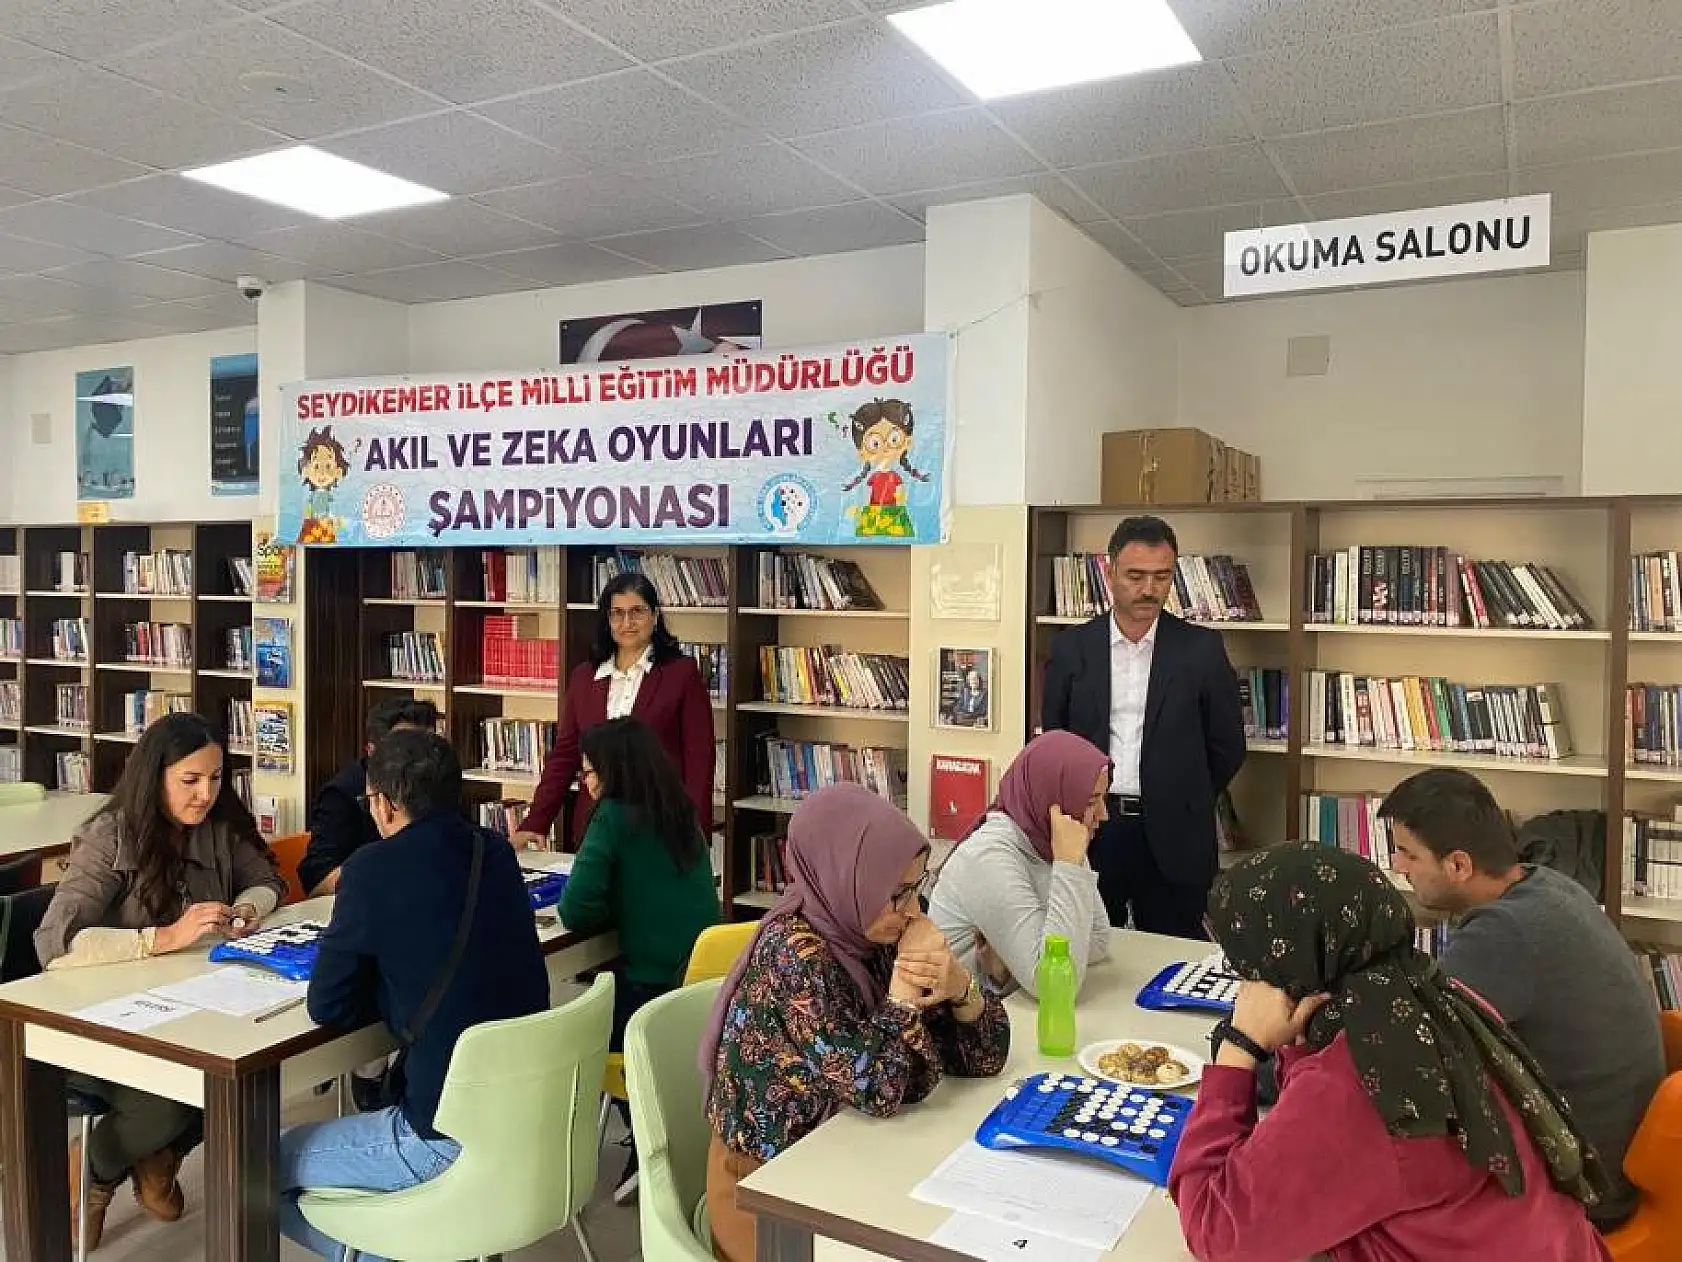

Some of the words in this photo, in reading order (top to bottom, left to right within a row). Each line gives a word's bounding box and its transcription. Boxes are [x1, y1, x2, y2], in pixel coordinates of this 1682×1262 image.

[1240, 234, 1365, 276] OKUMA
[1375, 215, 1530, 262] SALONU
[297, 384, 450, 420] SEYDİKEMER
[457, 380, 513, 413] İLÇE
[520, 374, 592, 406] MİLLİ
[599, 365, 697, 402] EĞİTİM
[706, 345, 914, 396] MÜDÜRLÜĞÜ
[363, 435, 439, 472] AKIL
[447, 431, 492, 468] VE
[501, 428, 598, 466] ZEKA
[608, 417, 813, 463] OYUNLARI
[427, 483, 730, 538] ŞAMPİYONASI
